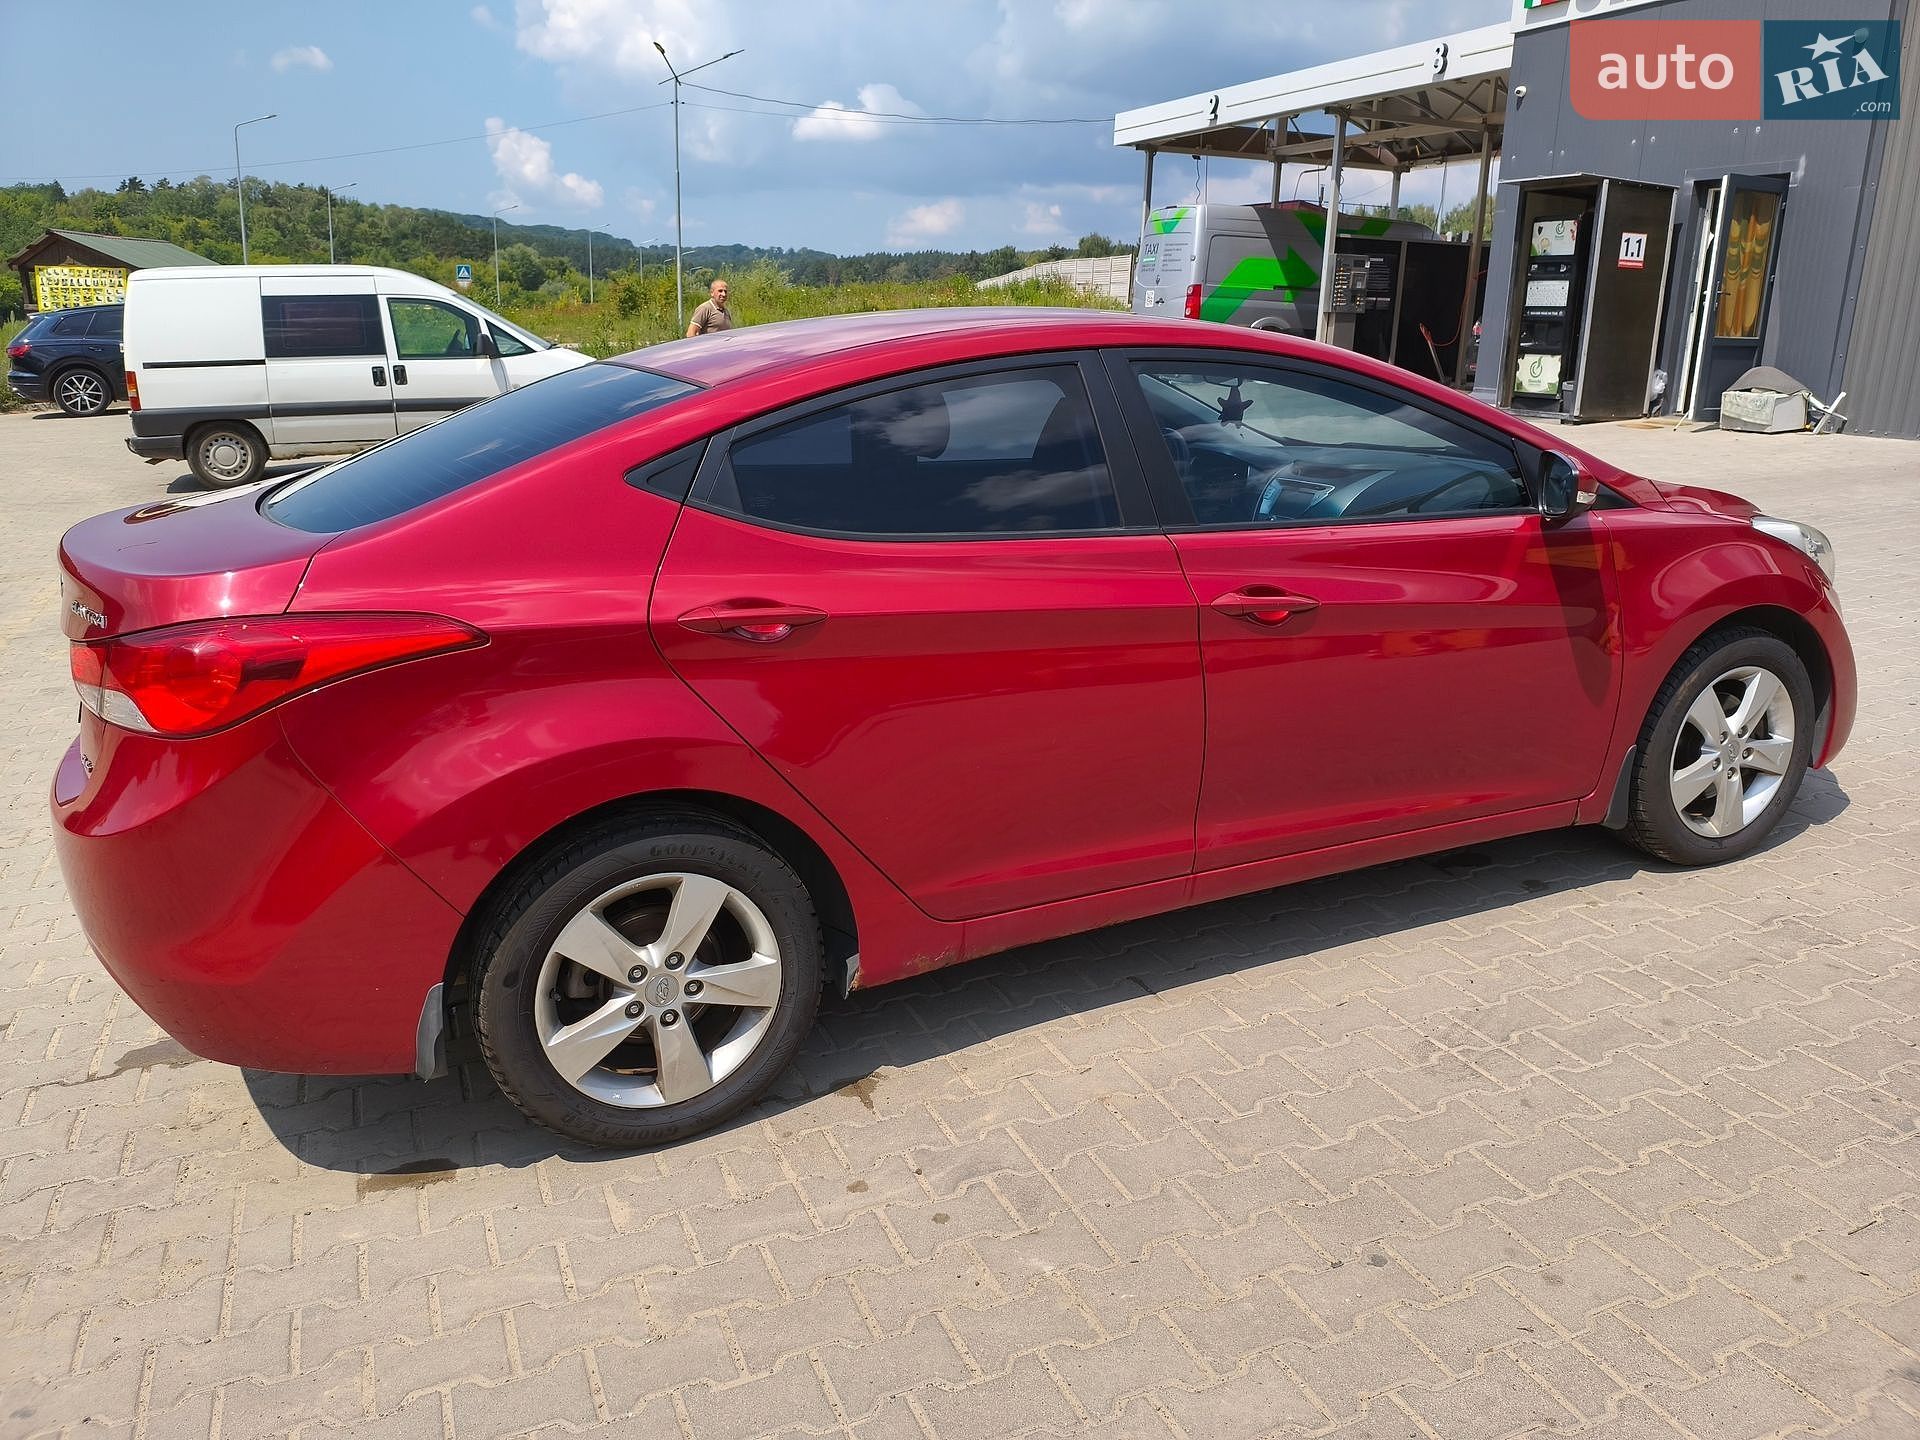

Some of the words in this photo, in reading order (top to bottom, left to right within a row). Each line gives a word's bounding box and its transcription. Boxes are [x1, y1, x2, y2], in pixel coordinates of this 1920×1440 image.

[1431, 41, 1449, 75] 3
[1207, 94, 1220, 120] 2
[1144, 243, 1160, 255] TAXI
[1624, 237, 1643, 258] 1.1
